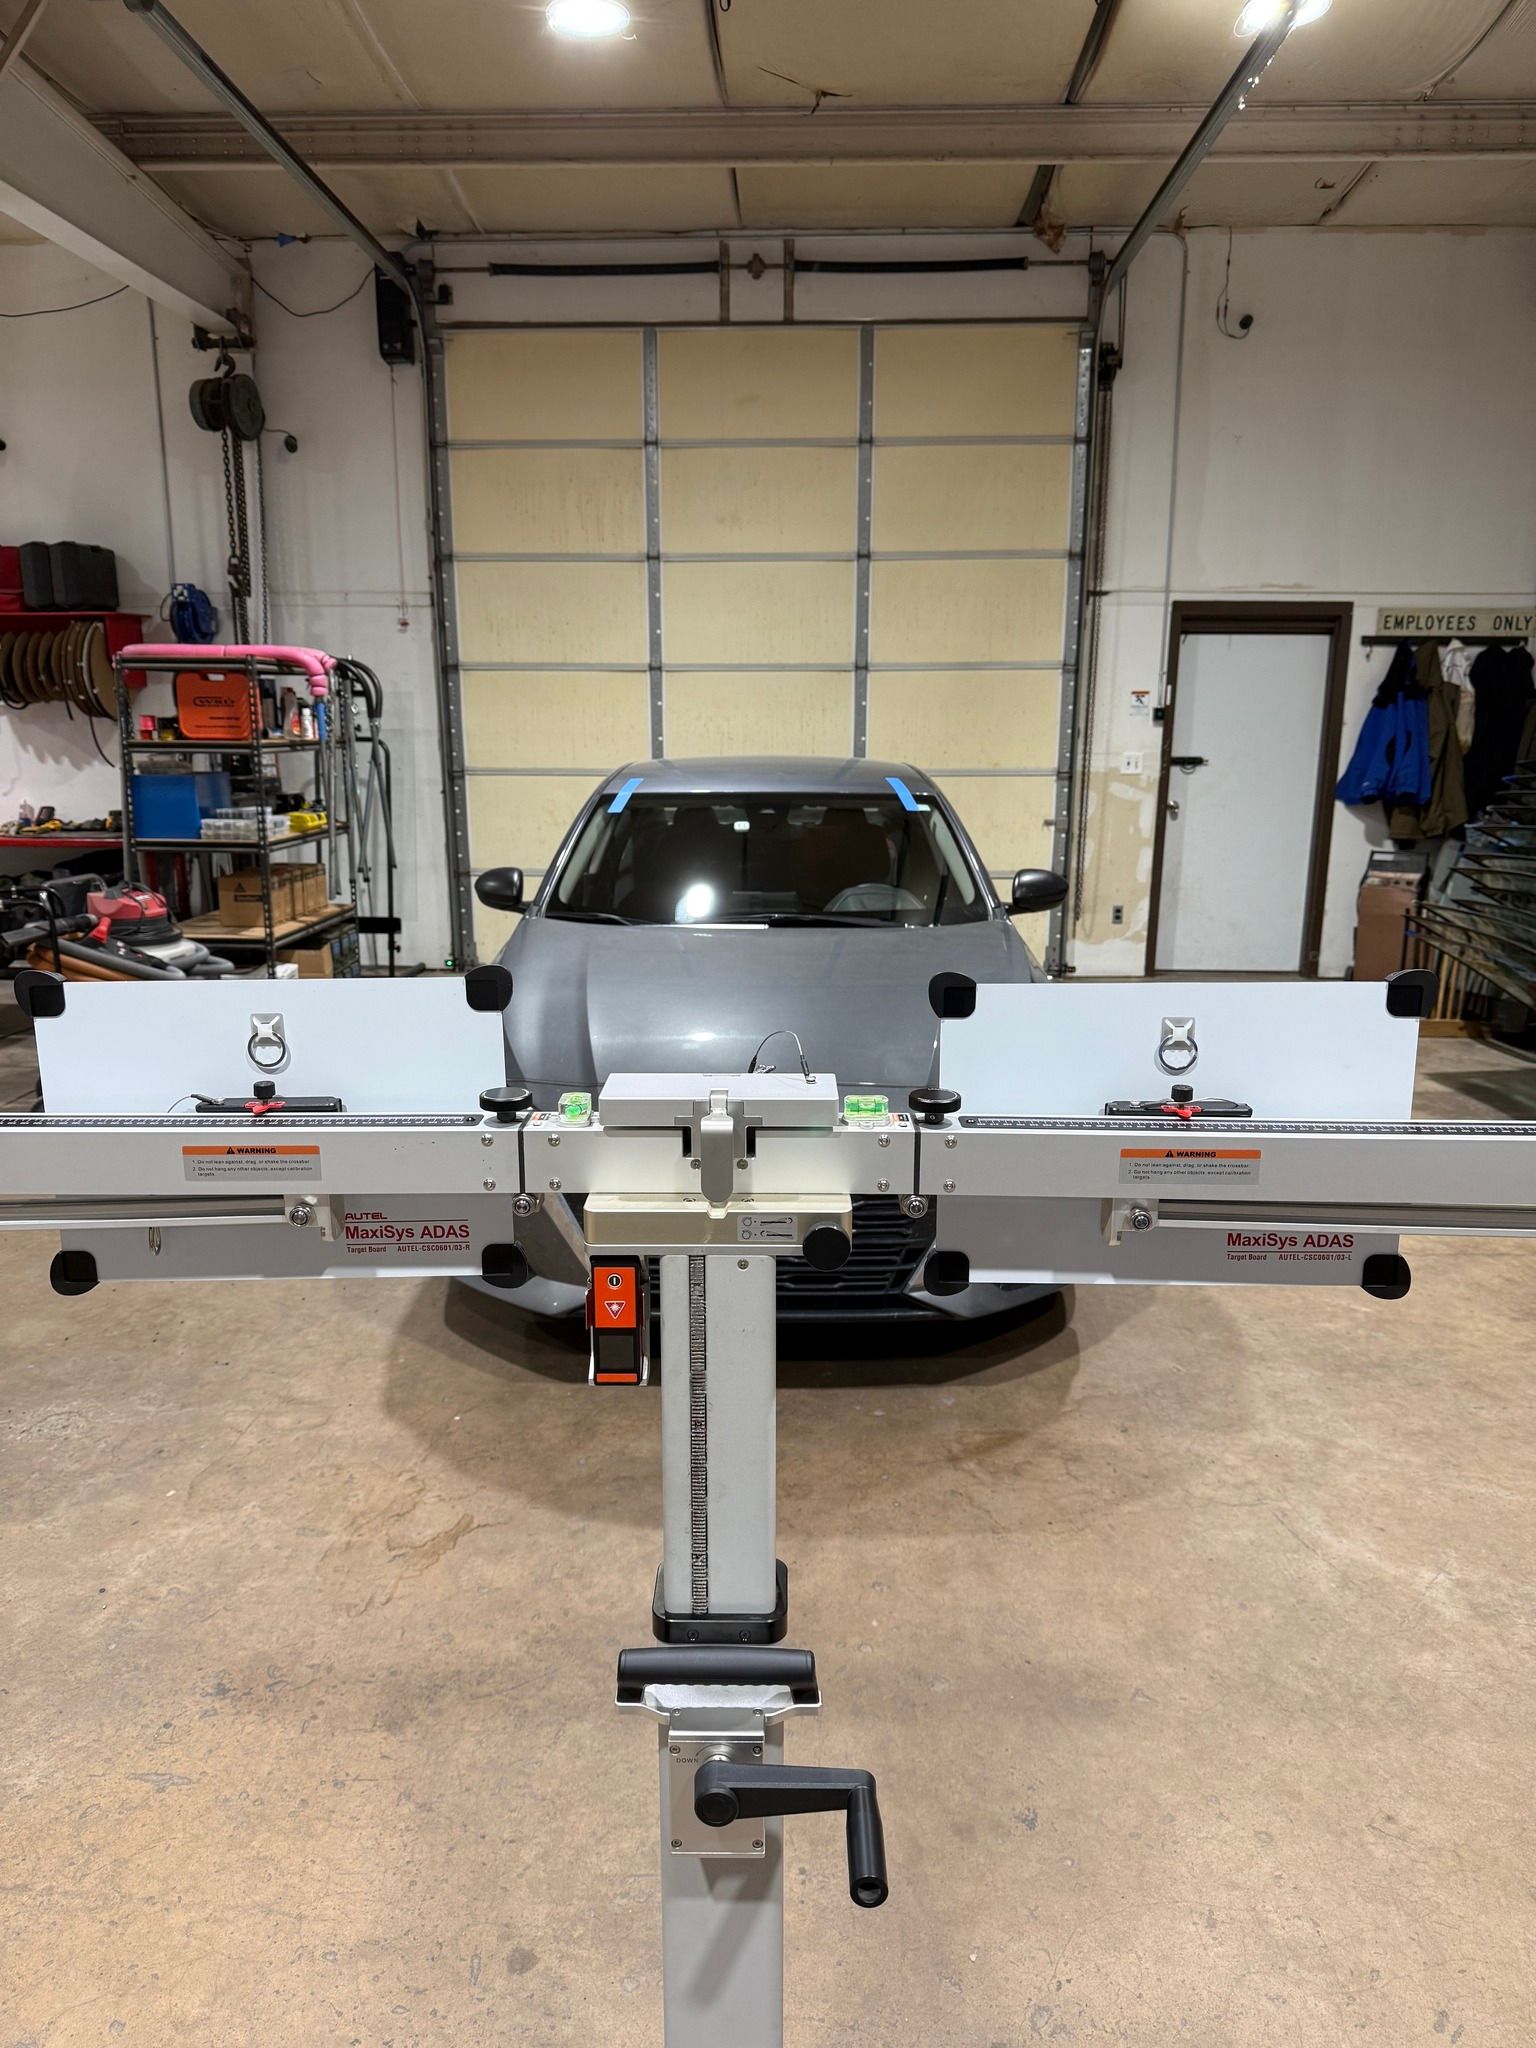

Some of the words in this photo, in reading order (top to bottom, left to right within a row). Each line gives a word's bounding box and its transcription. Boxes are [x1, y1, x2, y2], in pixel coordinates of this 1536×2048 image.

[1383, 614, 1477, 631] EMPLOYEES
[1493, 615, 1533, 631] ONLY
[344, 1212, 388, 1220] AUTEL
[345, 1225, 415, 1241] MaxiSys
[420, 1224, 470, 1239] ADAS
[1227, 1232, 1298, 1250] MaxiSys
[1303, 1234, 1354, 1248] ADAS
[347, 1246, 368, 1254] Target
[1227, 1253, 1247, 1261] Target
[1248, 1253, 1267, 1261] Board
